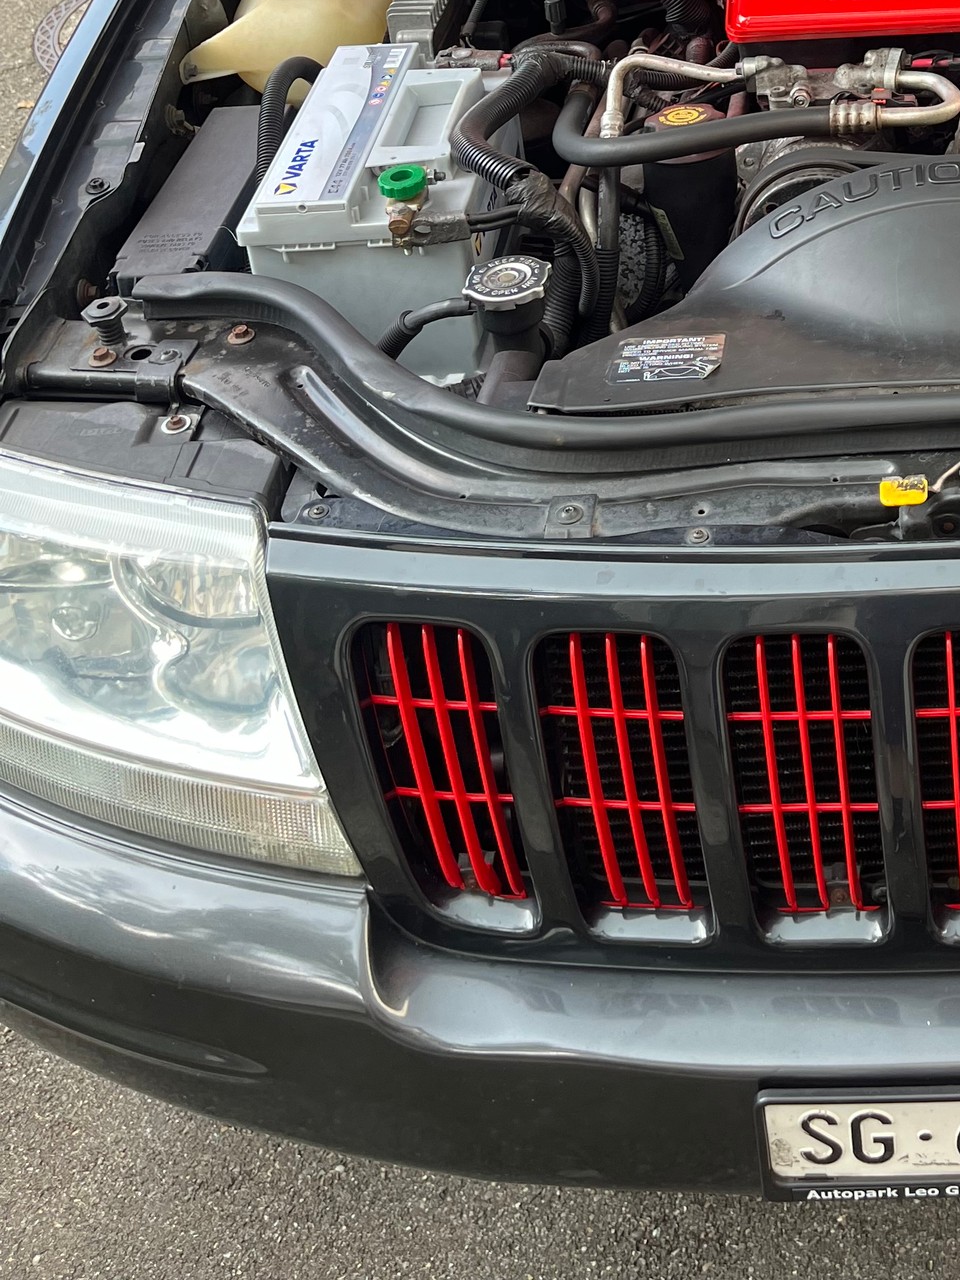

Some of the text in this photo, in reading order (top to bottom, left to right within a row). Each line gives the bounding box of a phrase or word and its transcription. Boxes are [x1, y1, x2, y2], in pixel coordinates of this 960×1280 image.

[281, 138, 319, 181] VARTA
[488, 257, 540, 269] KEEP TIGHT
[521, 277, 538, 288] HOT
[643, 337, 706, 345] IMPORTANT!
[799, 1108, 897, 1166] SG
[807, 1187, 899, 1201] Autopark
[904, 1186, 940, 1198] Leo
